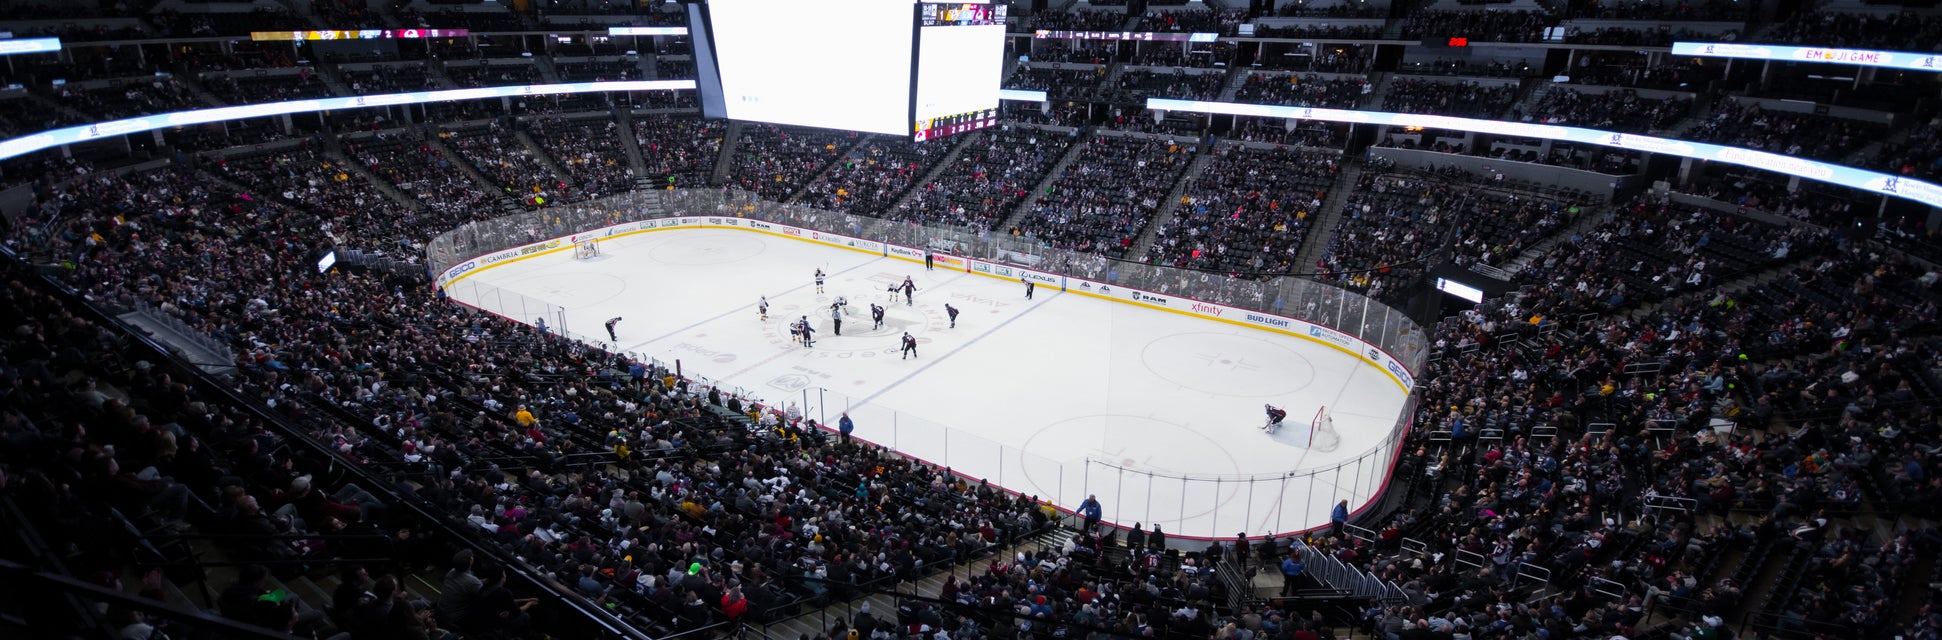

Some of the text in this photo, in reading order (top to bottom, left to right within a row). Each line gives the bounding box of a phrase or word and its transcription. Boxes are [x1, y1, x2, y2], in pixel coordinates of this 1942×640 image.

[1850, 53, 1881, 63] GAME
[487, 251, 519, 263] CAMBRIA
[891, 248, 911, 256] KeyBank
[450, 262, 475, 279] GEICO
[1028, 274, 1056, 283] LEXUS
[1142, 295, 1167, 304] RAM
[1191, 302, 1224, 317] xfinity
[1247, 314, 1289, 328] BUD LIGHT
[1321, 333, 1350, 346] AUTOMATION
[1387, 360, 1412, 389] GEICO
